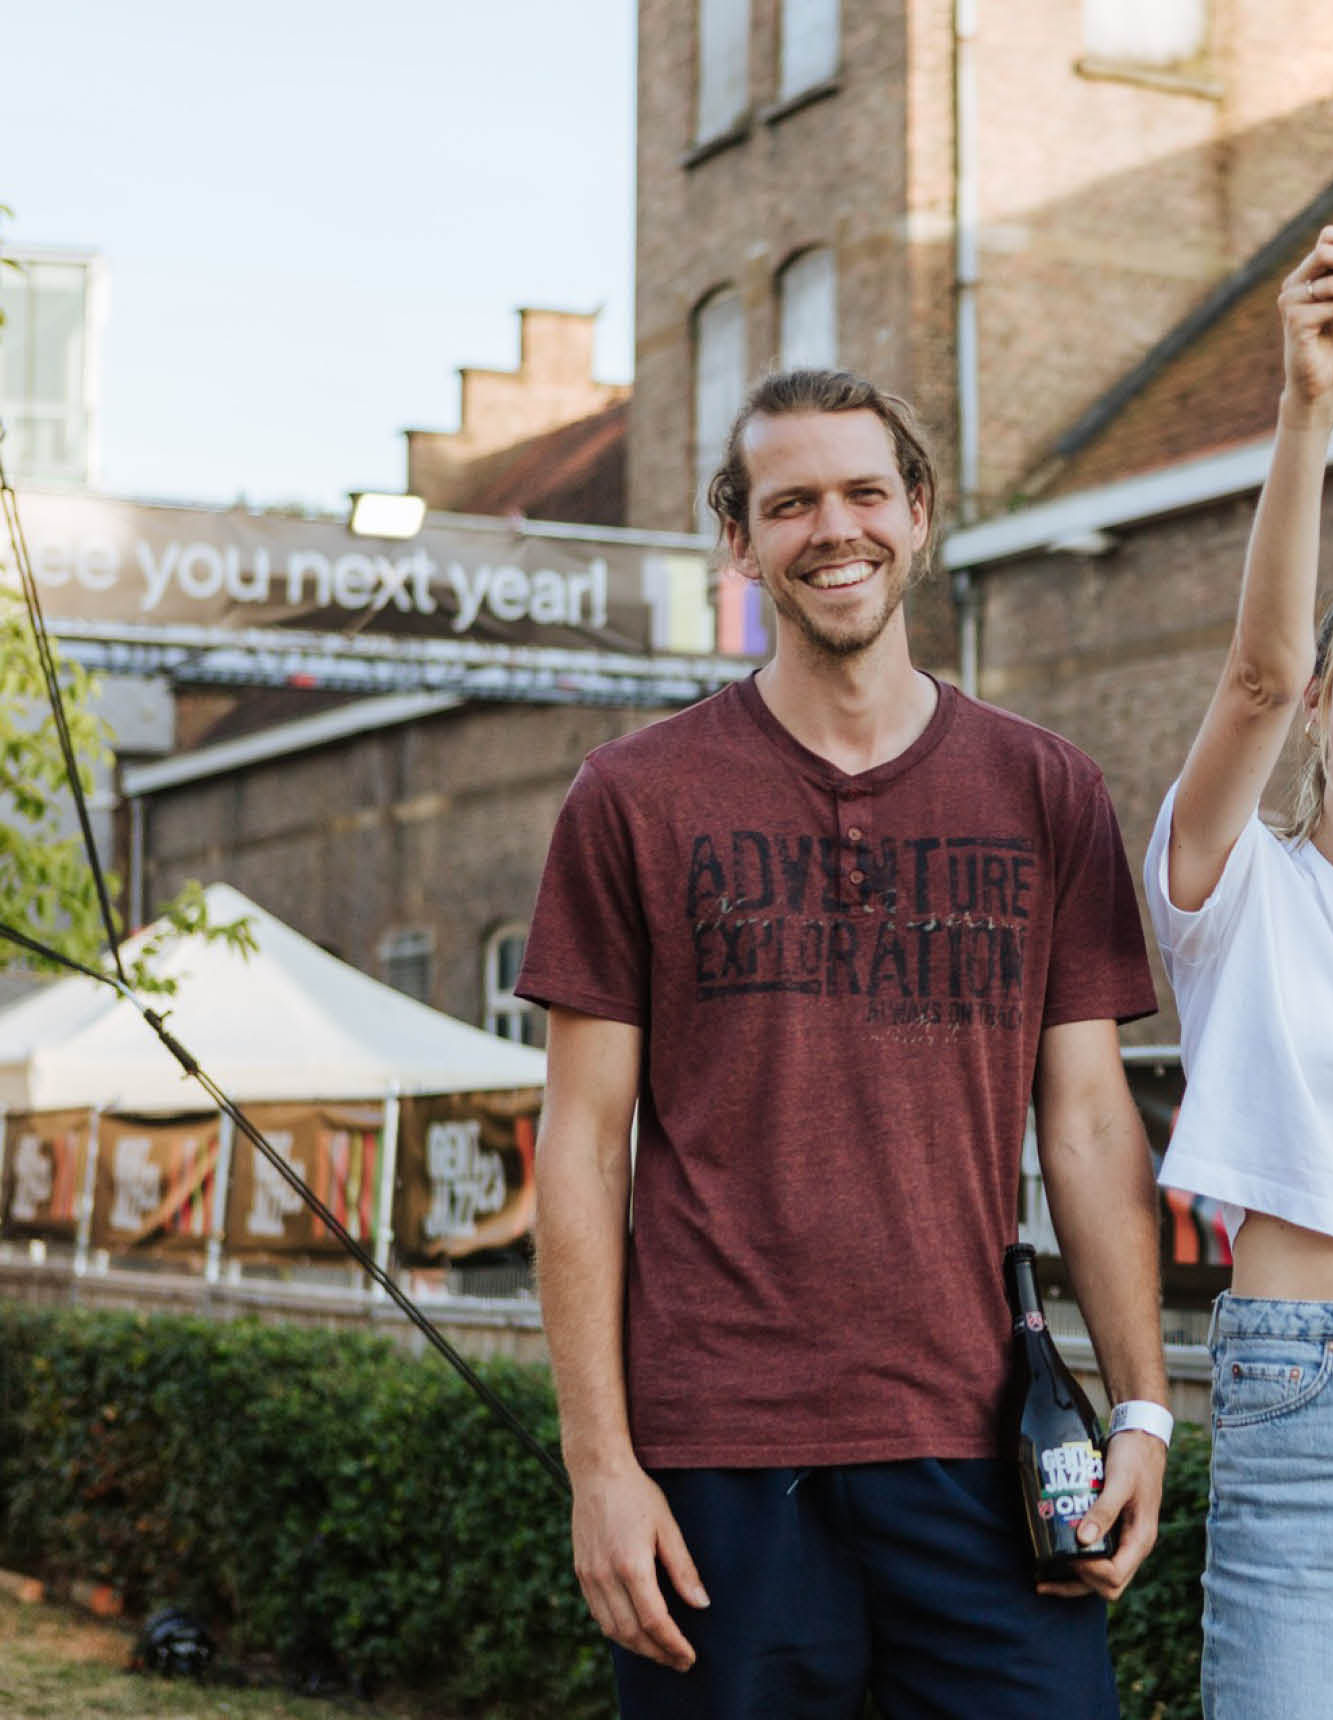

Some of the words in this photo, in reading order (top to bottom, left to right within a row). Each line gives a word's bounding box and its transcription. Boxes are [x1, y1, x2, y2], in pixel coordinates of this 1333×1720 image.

[14, 538, 119, 590] ee
[136, 541, 268, 611] you
[286, 548, 437, 615] next
[447, 556, 609, 634] year!
[686, 830, 1035, 920] ADVENTURE
[691, 919, 1026, 998] EXPLORATION
